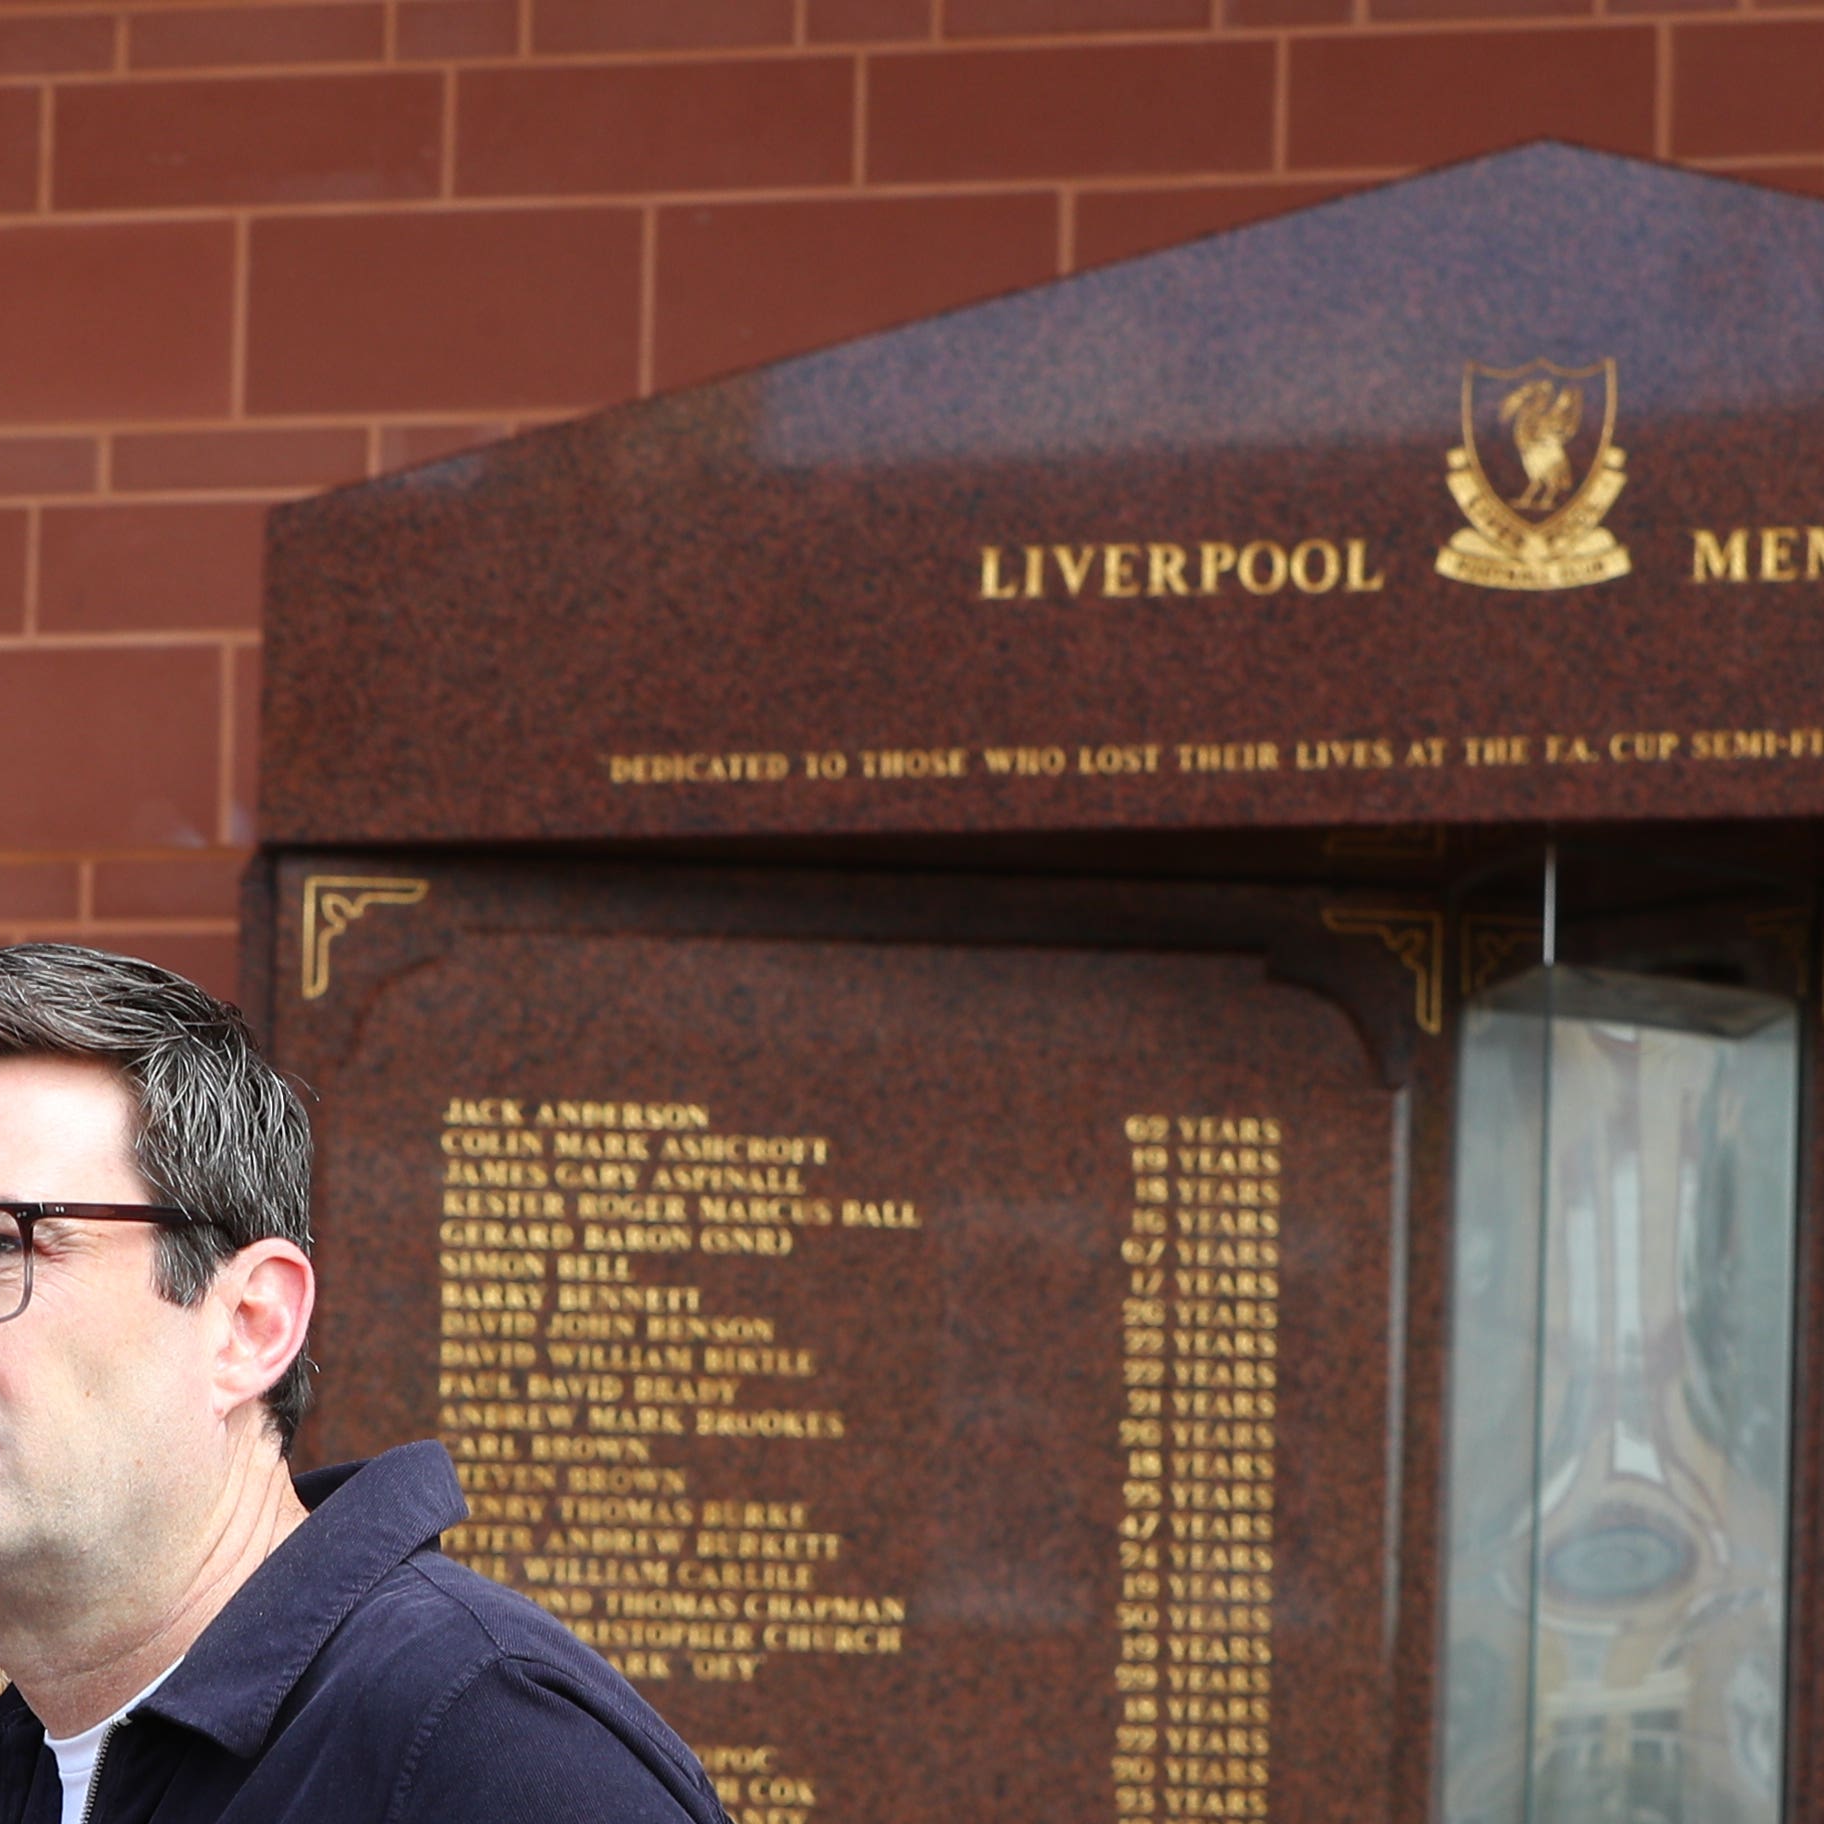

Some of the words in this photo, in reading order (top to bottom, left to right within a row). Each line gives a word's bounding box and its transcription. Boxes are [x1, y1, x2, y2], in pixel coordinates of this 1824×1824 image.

[978, 537, 1388, 601] LIVERPOOL
[802, 749, 851, 782] TO
[858, 746, 967, 781] THOSE
[980, 744, 1070, 777] WHO
[1075, 741, 1163, 777] LOST
[1174, 740, 1282, 774] THEIR
[1293, 738, 1397, 772] LIVES
[1404, 736, 1449, 769] AT
[1462, 734, 1530, 769] THE
[1605, 730, 1683, 764] CUP
[440, 1096, 526, 1127] JACK
[534, 1099, 712, 1132] ANDERSON
[1175, 1114, 1285, 1147] YEARS
[437, 1129, 546, 1157] COLIN
[551, 1130, 652, 1163] MARK
[660, 1133, 831, 1167] ASHCROFT
[441, 1157, 552, 1190] JAMES
[551, 1161, 642, 1192] GARY
[651, 1164, 807, 1197] ASPINALL
[1174, 1176, 1284, 1207] YEARS
[574, 1191, 689, 1224] ROGER
[696, 1194, 835, 1227] MARCUS
[838, 1198, 923, 1230] BALL
[1174, 1207, 1282, 1239] YEARS
[436, 1219, 577, 1251] GERARD
[581, 1222, 695, 1254] BARON
[1117, 1236, 1169, 1267] 67
[1173, 1237, 1282, 1268] YEARS
[436, 1250, 549, 1279] SIMON
[554, 1252, 634, 1284] BELL
[438, 1280, 547, 1312] BARRY
[1128, 1268, 1167, 1297] 17
[1172, 1268, 1282, 1300] YEARS
[437, 1308, 540, 1338] DAVID
[544, 1311, 638, 1340] JOHN
[644, 1313, 777, 1343] BENSON
[1172, 1299, 1281, 1331] YEARS
[436, 1339, 540, 1369] DAVID
[545, 1342, 695, 1374] WILLIAM
[1170, 1328, 1281, 1360] YEARS
[524, 1371, 626, 1404] DAVID
[630, 1373, 741, 1406] BRADY
[1169, 1389, 1279, 1420] YEARS
[437, 1402, 578, 1432] ANDREW
[585, 1404, 687, 1436] MARK
[693, 1407, 848, 1440] BROOKES
[528, 1433, 652, 1463] BROWN
[565, 1465, 690, 1495] BROWN
[1168, 1480, 1277, 1512] YEARS
[556, 1494, 697, 1527] THOMAS
[699, 1499, 809, 1530] BURKE
[1116, 1509, 1163, 1541] 47
[1167, 1512, 1276, 1541] YEARS
[544, 1526, 685, 1556] ANDREW
[693, 1529, 844, 1563] BURKETT
[520, 1555, 672, 1588] WILLIAM
[602, 1588, 741, 1620] THOMAS
[740, 1593, 908, 1624] CHAPMAN
[759, 1622, 905, 1655] CHURCH
